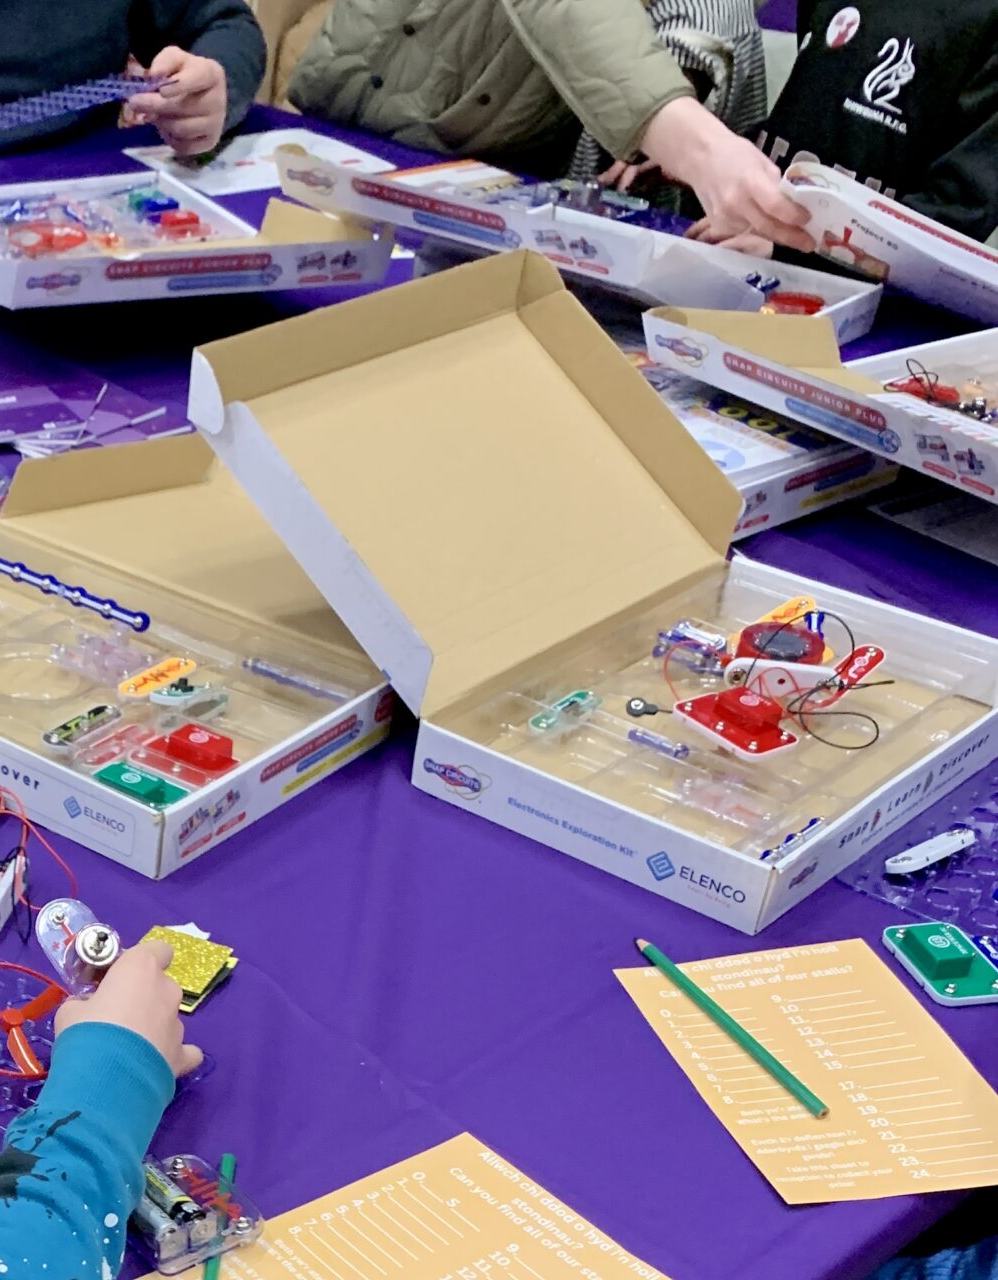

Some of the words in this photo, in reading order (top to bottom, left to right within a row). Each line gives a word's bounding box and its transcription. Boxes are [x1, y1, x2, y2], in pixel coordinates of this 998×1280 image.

[726, 355, 754, 377] SNAP
[755, 367, 807, 396] CIRCUITS
[854, 405, 886, 428] PLUS
[839, 820, 870, 849] Snap
[938, 733, 991, 777] Discover
[82, 806, 126, 833] ELENCO
[507, 796, 560, 827] Electronics
[561, 819, 618, 851] Exploration
[678, 866, 746, 904] ELENCO
[691, 962, 713, 972] chi
[714, 955, 751, 969] ddod
[763, 951, 791, 962] hyd
[810, 944, 840, 955] holl
[710, 963, 785, 982] stondinau?
[716, 981, 746, 991] find
[748, 977, 765, 987] all
[767, 974, 782, 984] of
[784, 972, 808, 982] our
[810, 964, 854, 978] stalls?
[396, 1177, 409, 1189] 1.
[412, 1171, 427, 1184] 0.
[365, 1191, 380, 1204] 3.
[381, 1183, 395, 1196] 2.
[335, 1204, 350, 1218] 5.
[352, 1199, 365, 1211] 4.
[478, 1151, 521, 1183] Allwch
[519, 1182, 544, 1198] chi
[539, 1197, 580, 1224] ddod
[573, 1222, 586, 1232] o
[583, 1229, 618, 1252] hyd
[610, 1249, 631, 1264] i'n
[304, 1218, 319, 1231] 7.
[320, 1212, 334, 1225] 6.
[449, 1166, 475, 1186] Can
[469, 1186, 500, 1206] you
[496, 1203, 528, 1226] find
[522, 1225, 545, 1240] all
[540, 1238, 562, 1250] of
[555, 1249, 582, 1268] our
[510, 1197, 585, 1250] stondinau?
[288, 1225, 303, 1238] 8.
[505, 1242, 520, 1256] 9.
[472, 1258, 492, 1276] 11.
[488, 1250, 511, 1270] 10.
